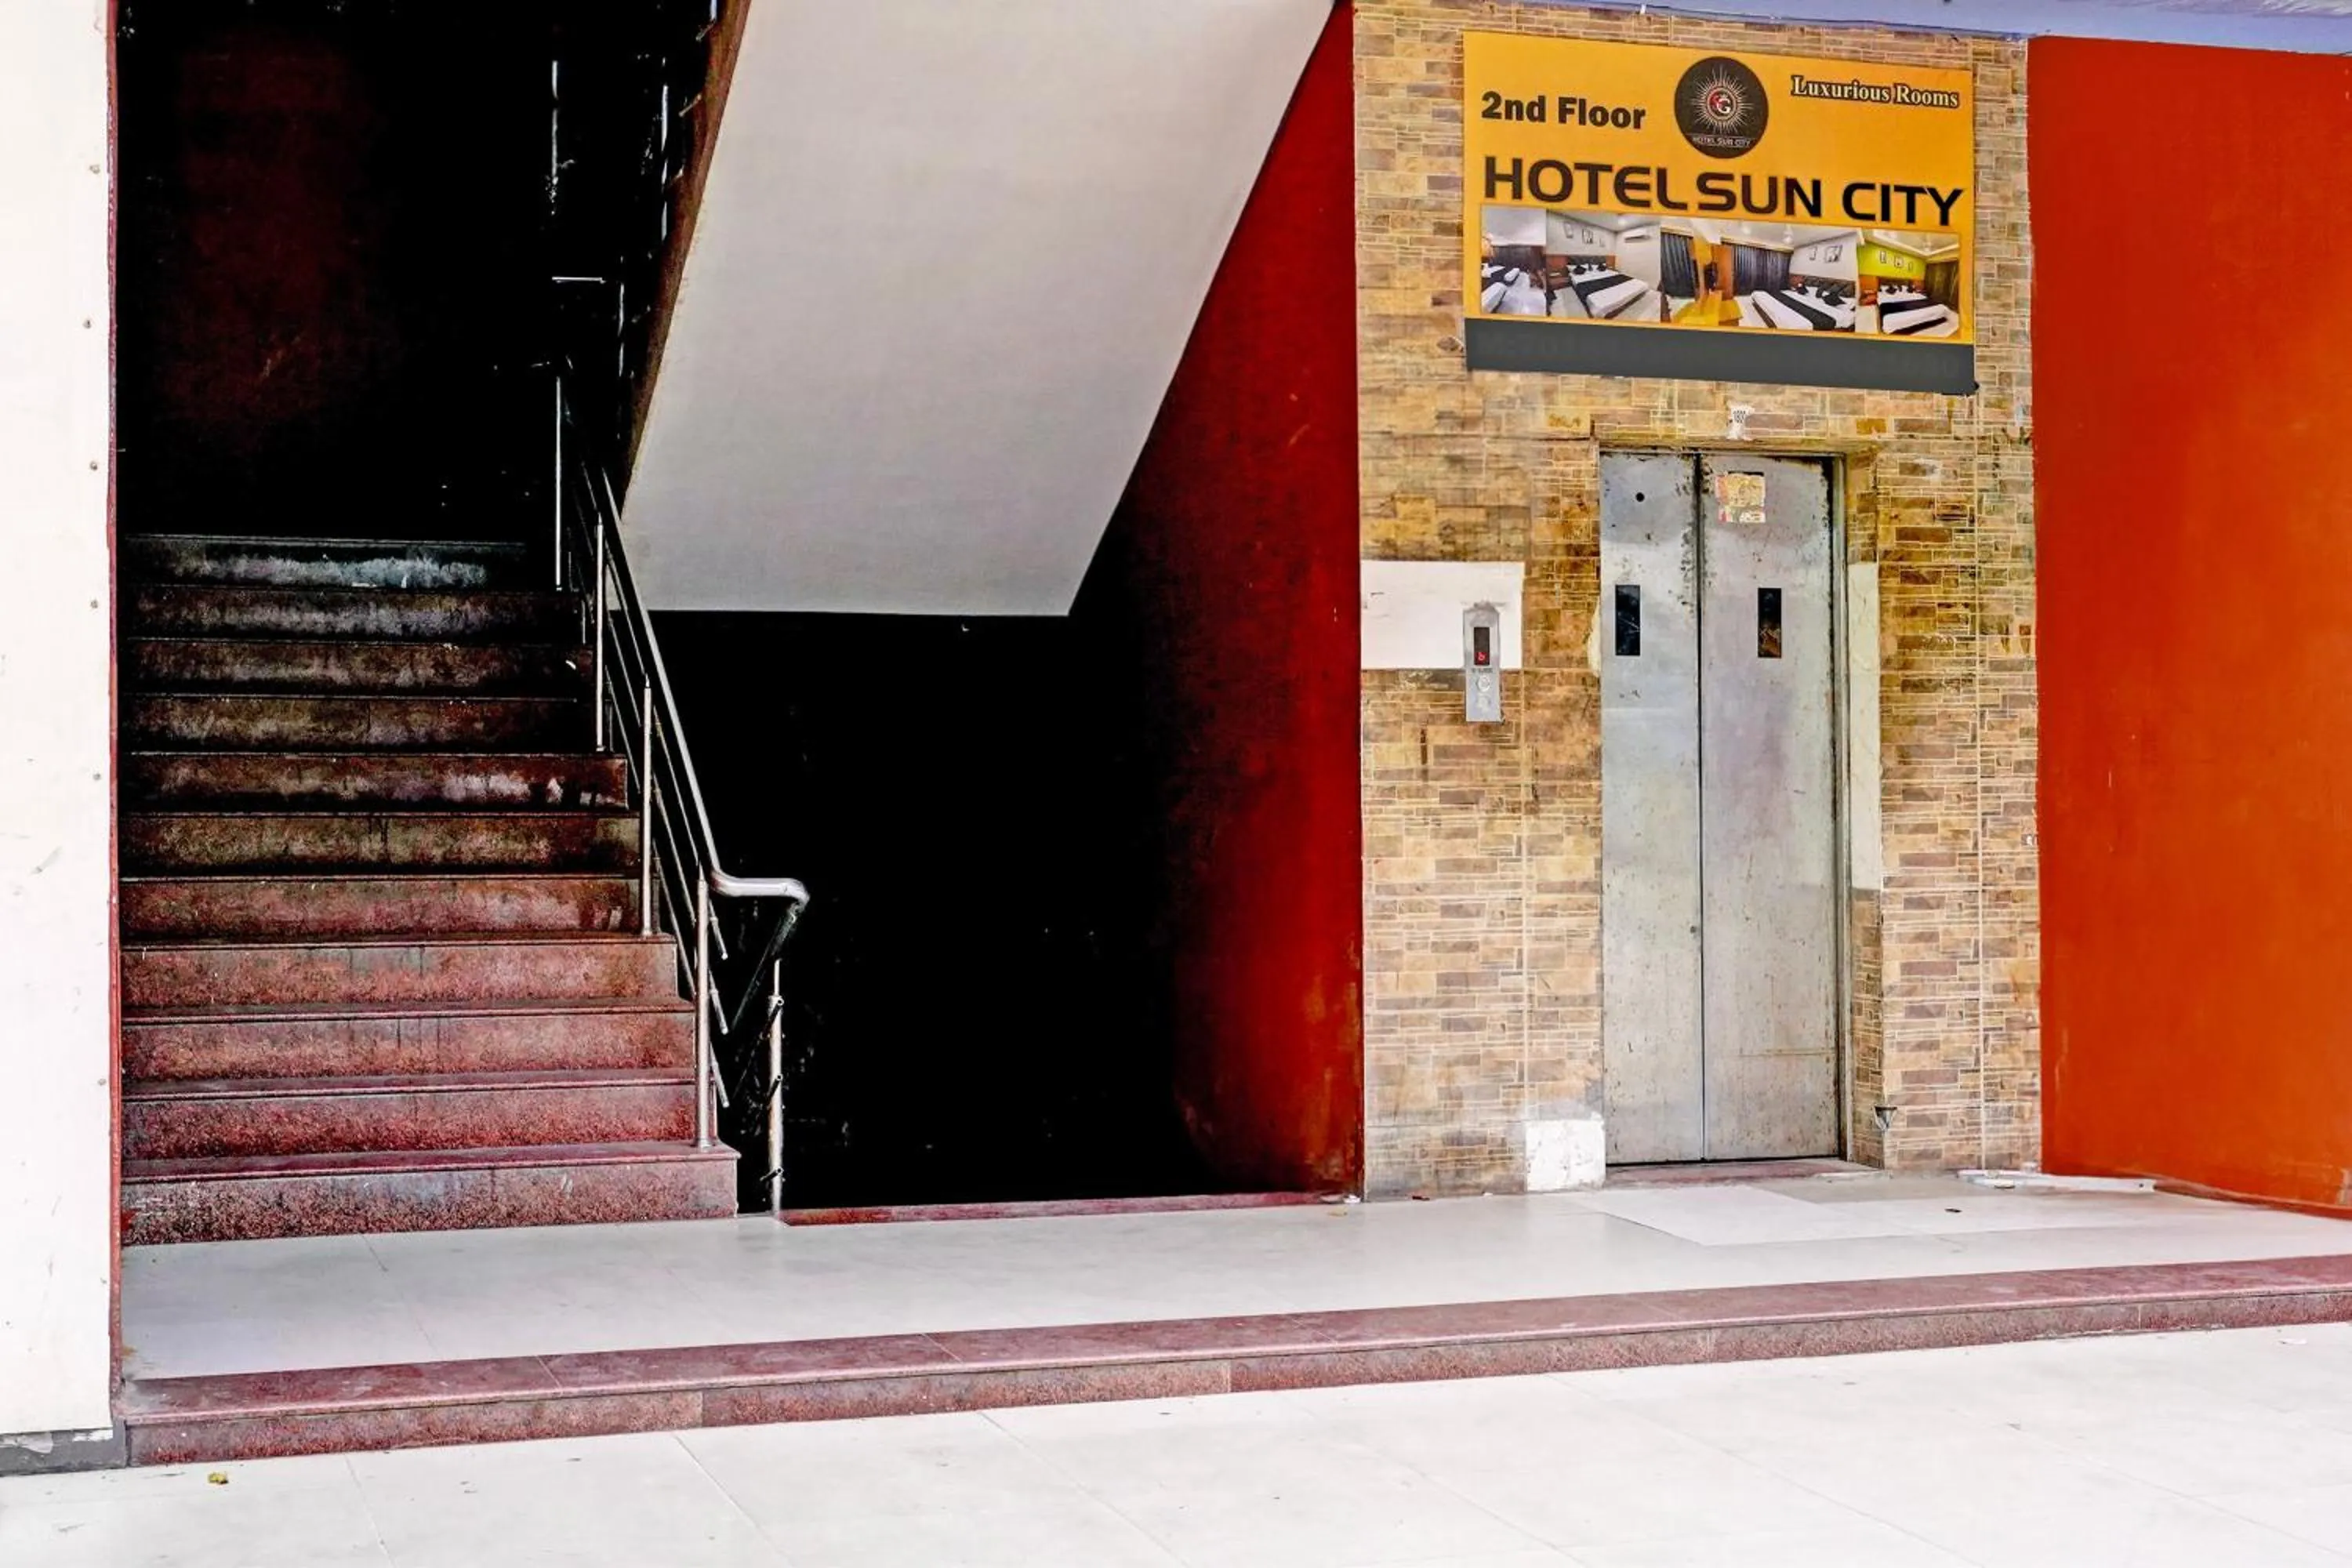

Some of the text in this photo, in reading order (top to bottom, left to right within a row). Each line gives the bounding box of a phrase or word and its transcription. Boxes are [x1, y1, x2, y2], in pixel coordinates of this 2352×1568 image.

[1482, 90, 1646, 129] 2nd Floor
[1792, 75, 1960, 108] Luxurious Rooms
[1842, 183, 1963, 226] CITY
